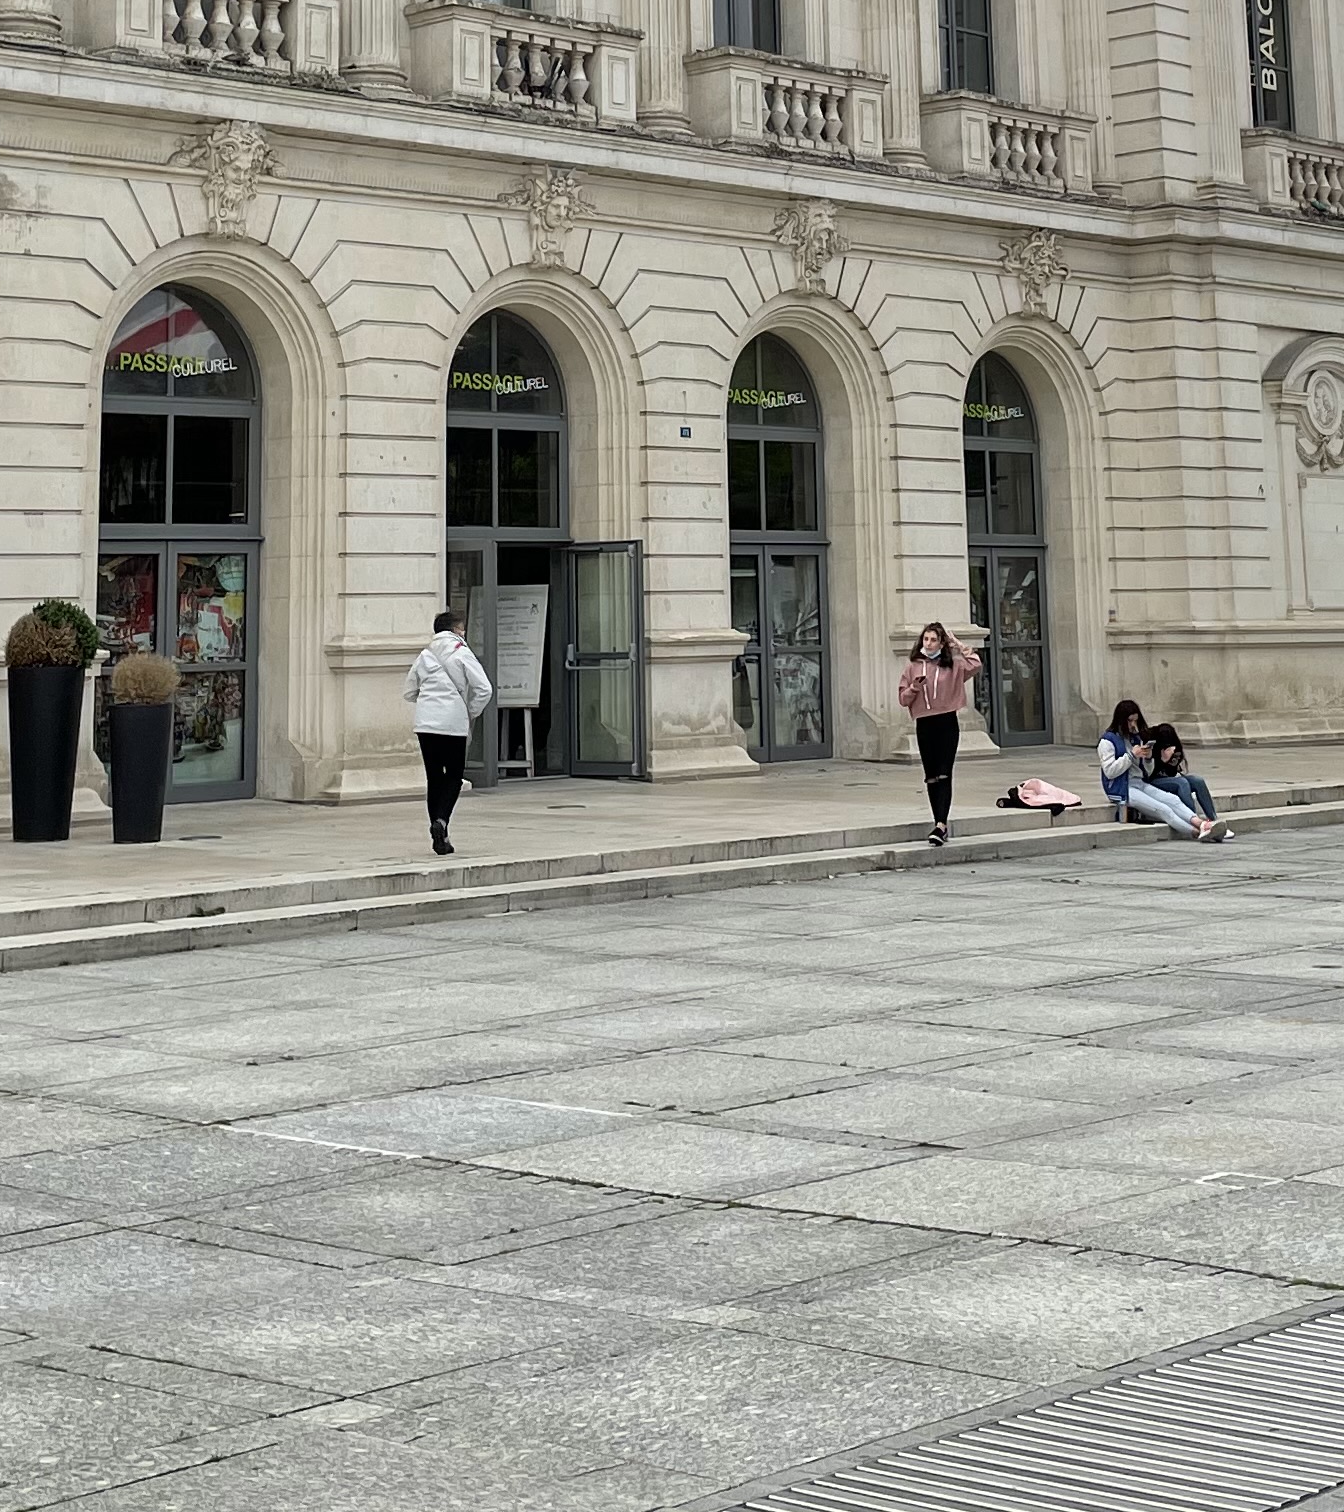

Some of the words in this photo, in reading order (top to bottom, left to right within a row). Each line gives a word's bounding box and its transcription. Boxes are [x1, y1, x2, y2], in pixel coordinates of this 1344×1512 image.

[172, 357, 238, 378] CULTUREL
[496, 377, 549, 395] CULTUREL
[761, 392, 807, 409] CULTUREL
[964, 403, 1006, 418] ASSAGE
